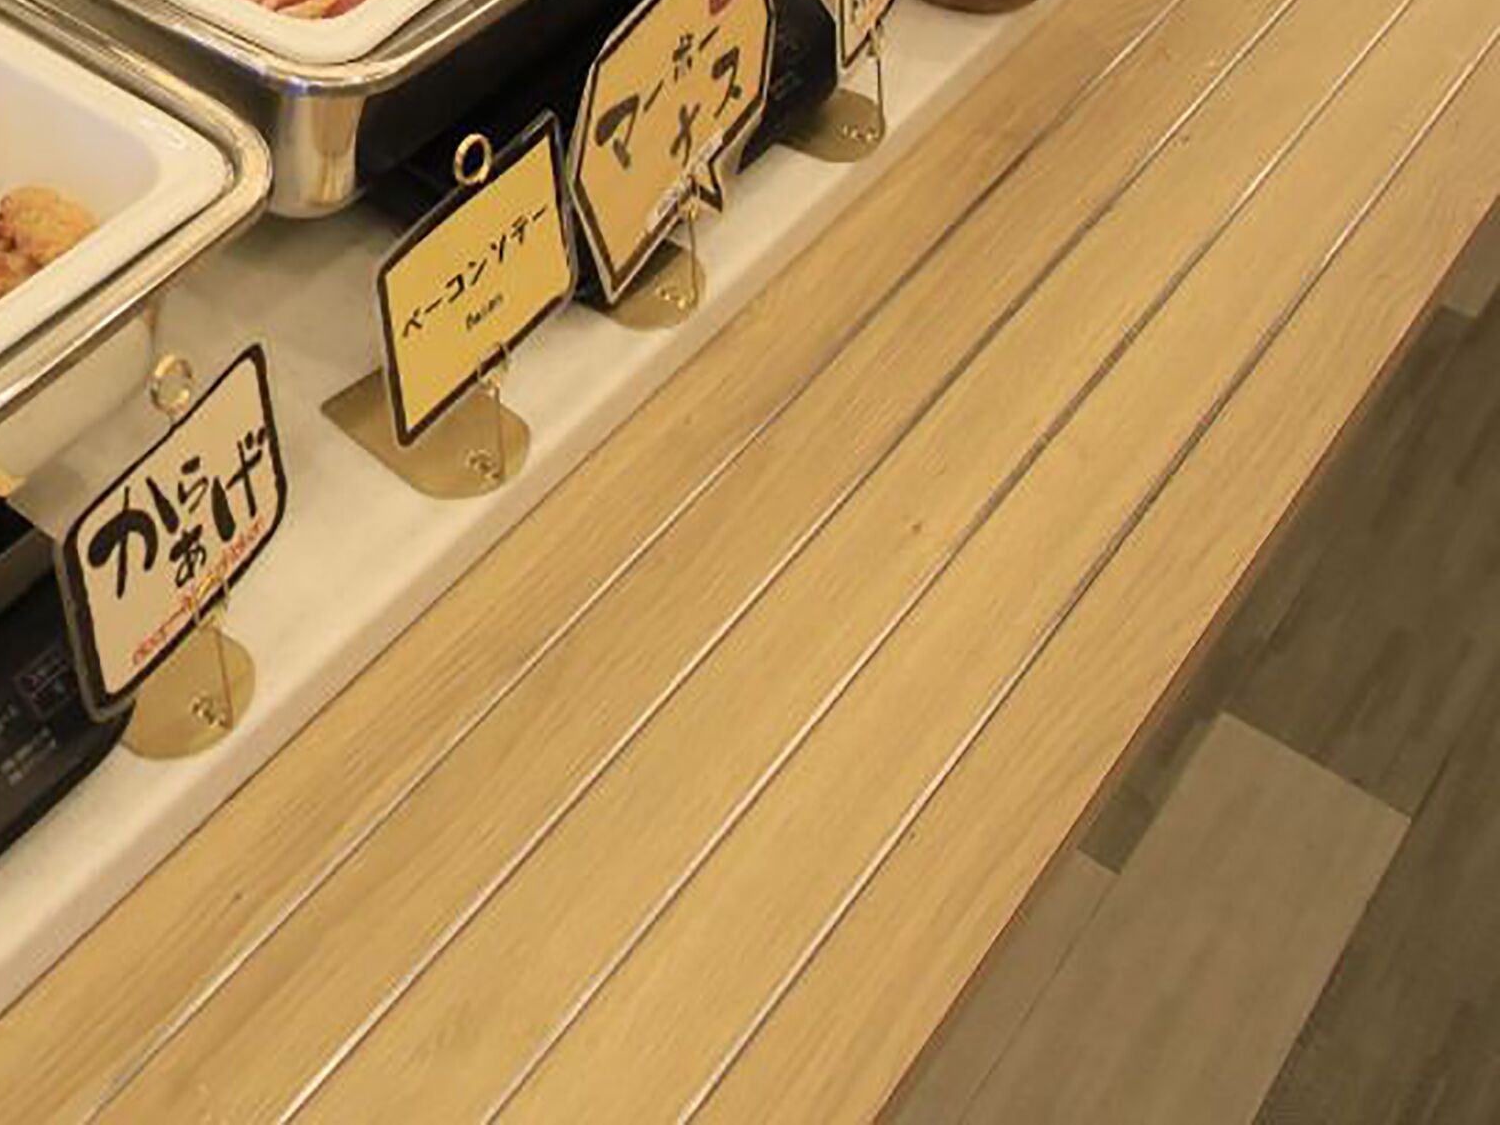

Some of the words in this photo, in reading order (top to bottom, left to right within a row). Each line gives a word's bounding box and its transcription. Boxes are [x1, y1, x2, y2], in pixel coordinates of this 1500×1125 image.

[595, 25, 720, 169] マーボー
[401, 205, 547, 338] ベーコンソテー
[86, 426, 269, 600] からあげ
